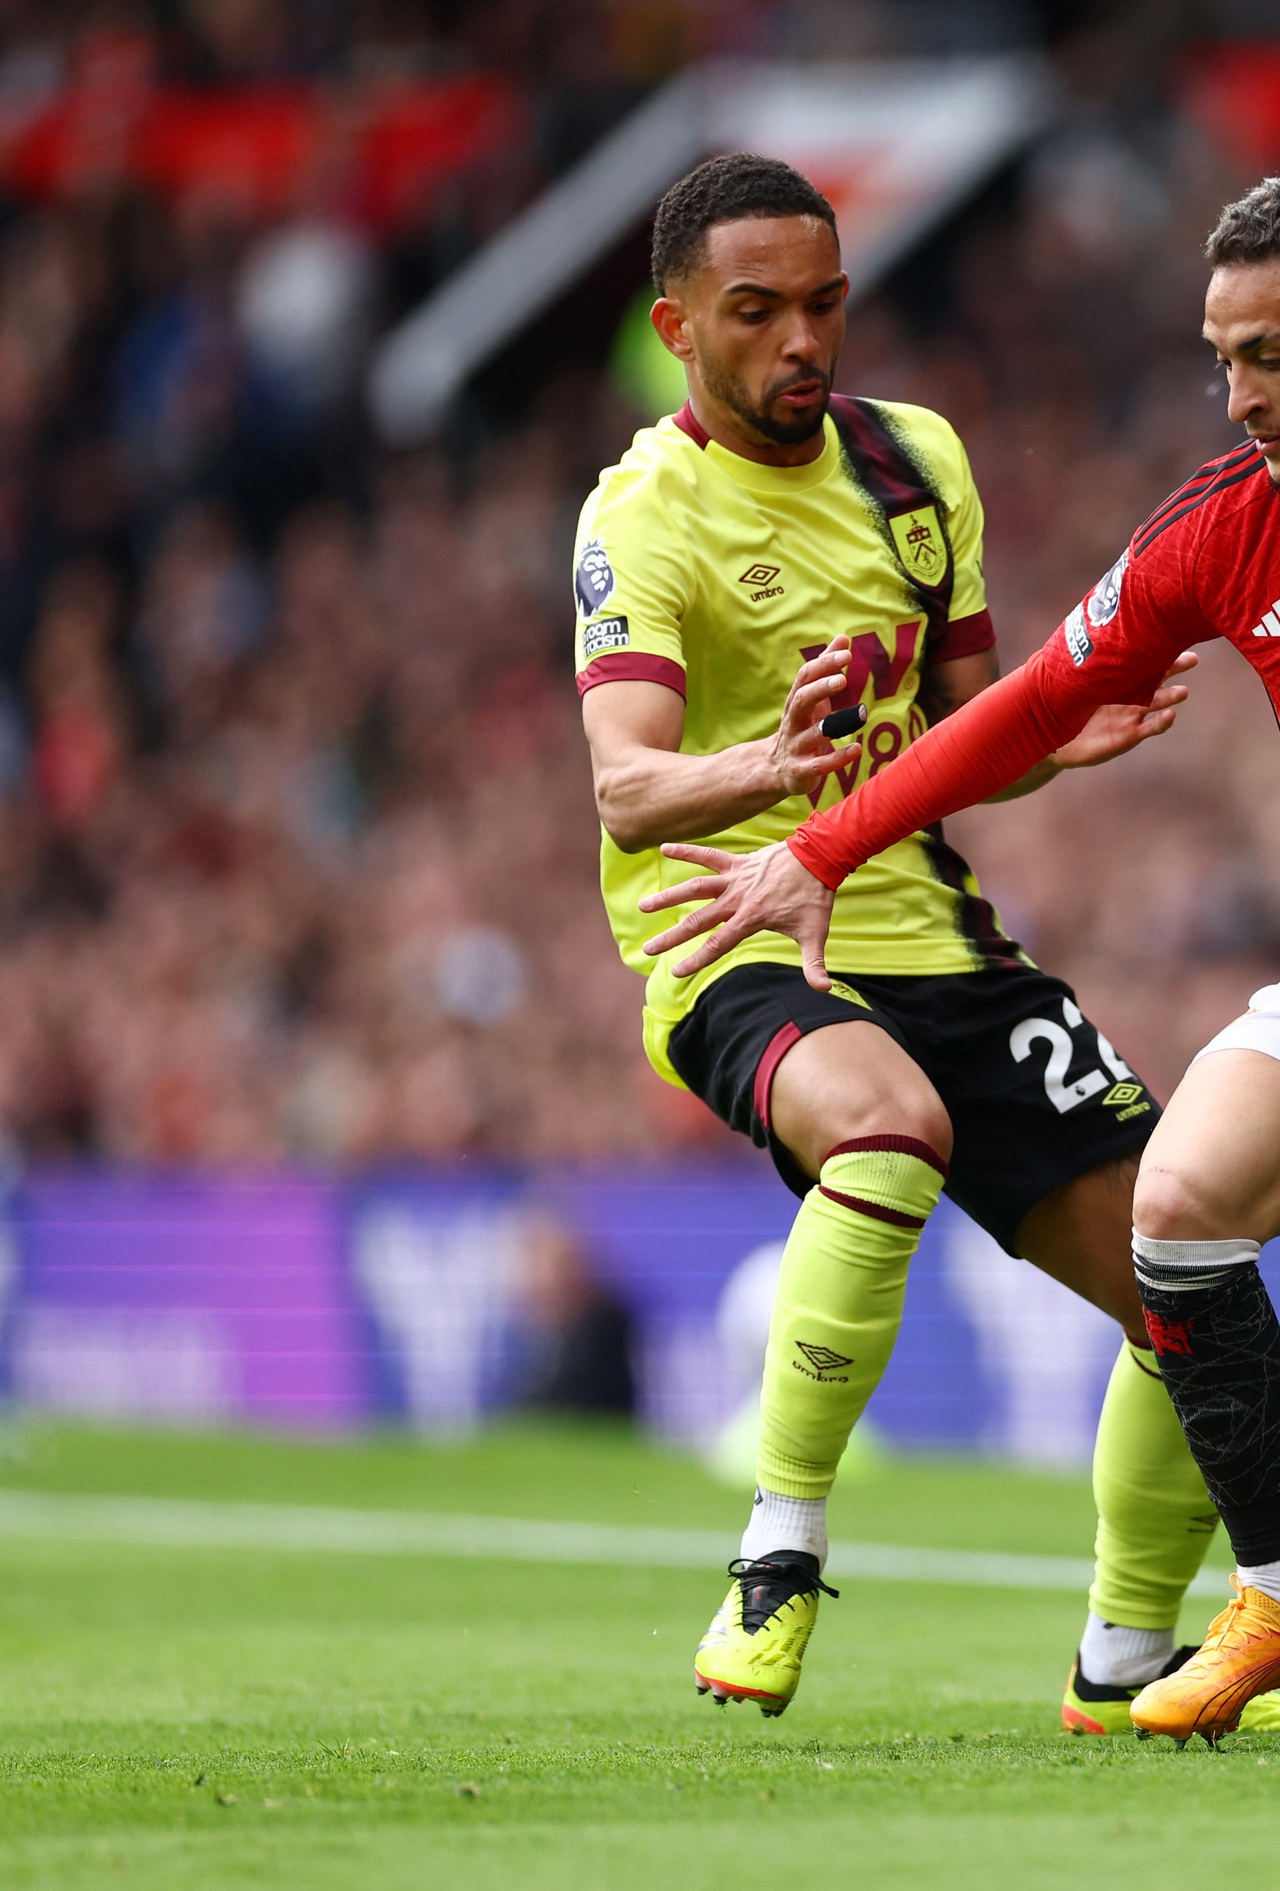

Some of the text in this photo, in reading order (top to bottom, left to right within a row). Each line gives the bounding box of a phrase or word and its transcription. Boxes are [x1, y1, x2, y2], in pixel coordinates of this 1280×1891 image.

[750, 586, 784, 602] umbro
[1115, 1101, 1151, 1122] umbro
[792, 1361, 849, 1384] umbro
